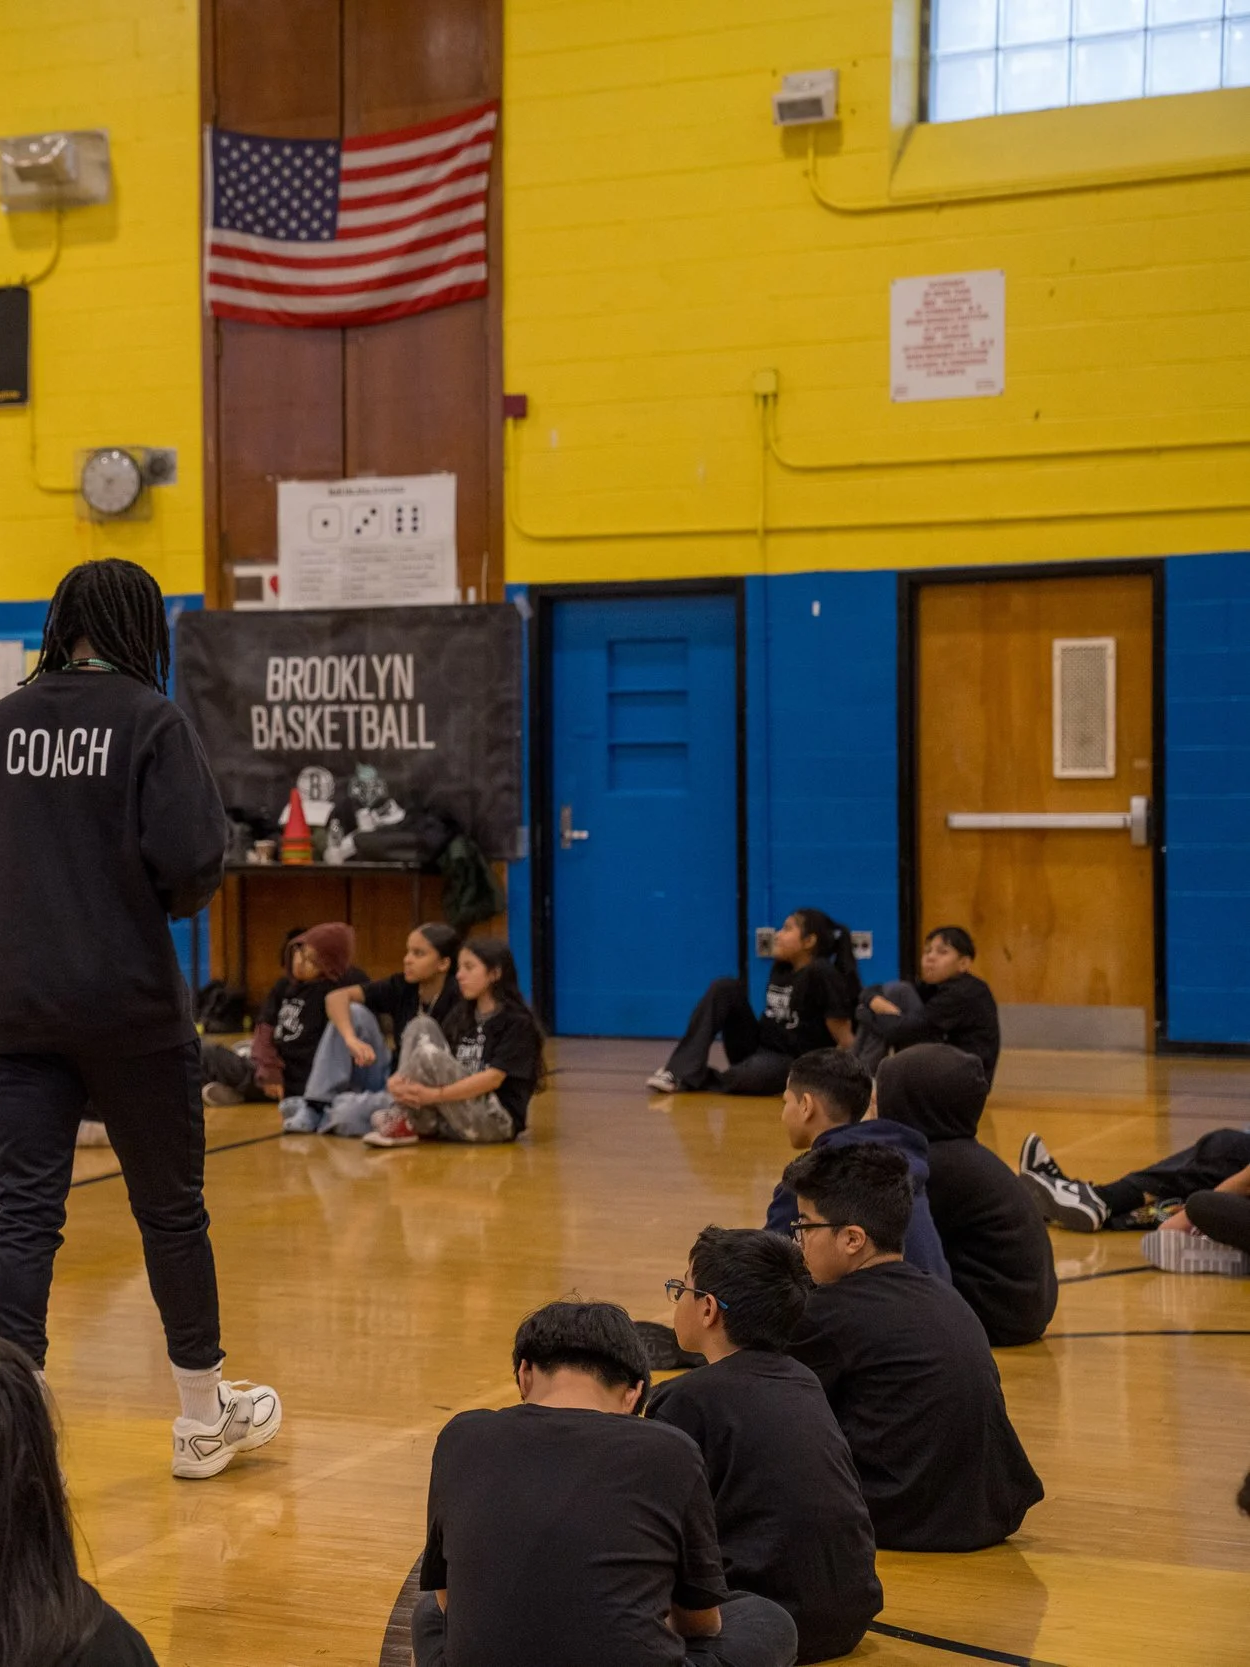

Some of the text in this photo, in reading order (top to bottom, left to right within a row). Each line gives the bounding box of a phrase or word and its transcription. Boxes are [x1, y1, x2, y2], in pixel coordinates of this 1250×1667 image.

[266, 653, 414, 701] BROOKLYN
[251, 703, 436, 750] BASKETBALL
[6, 727, 112, 778] COACH
